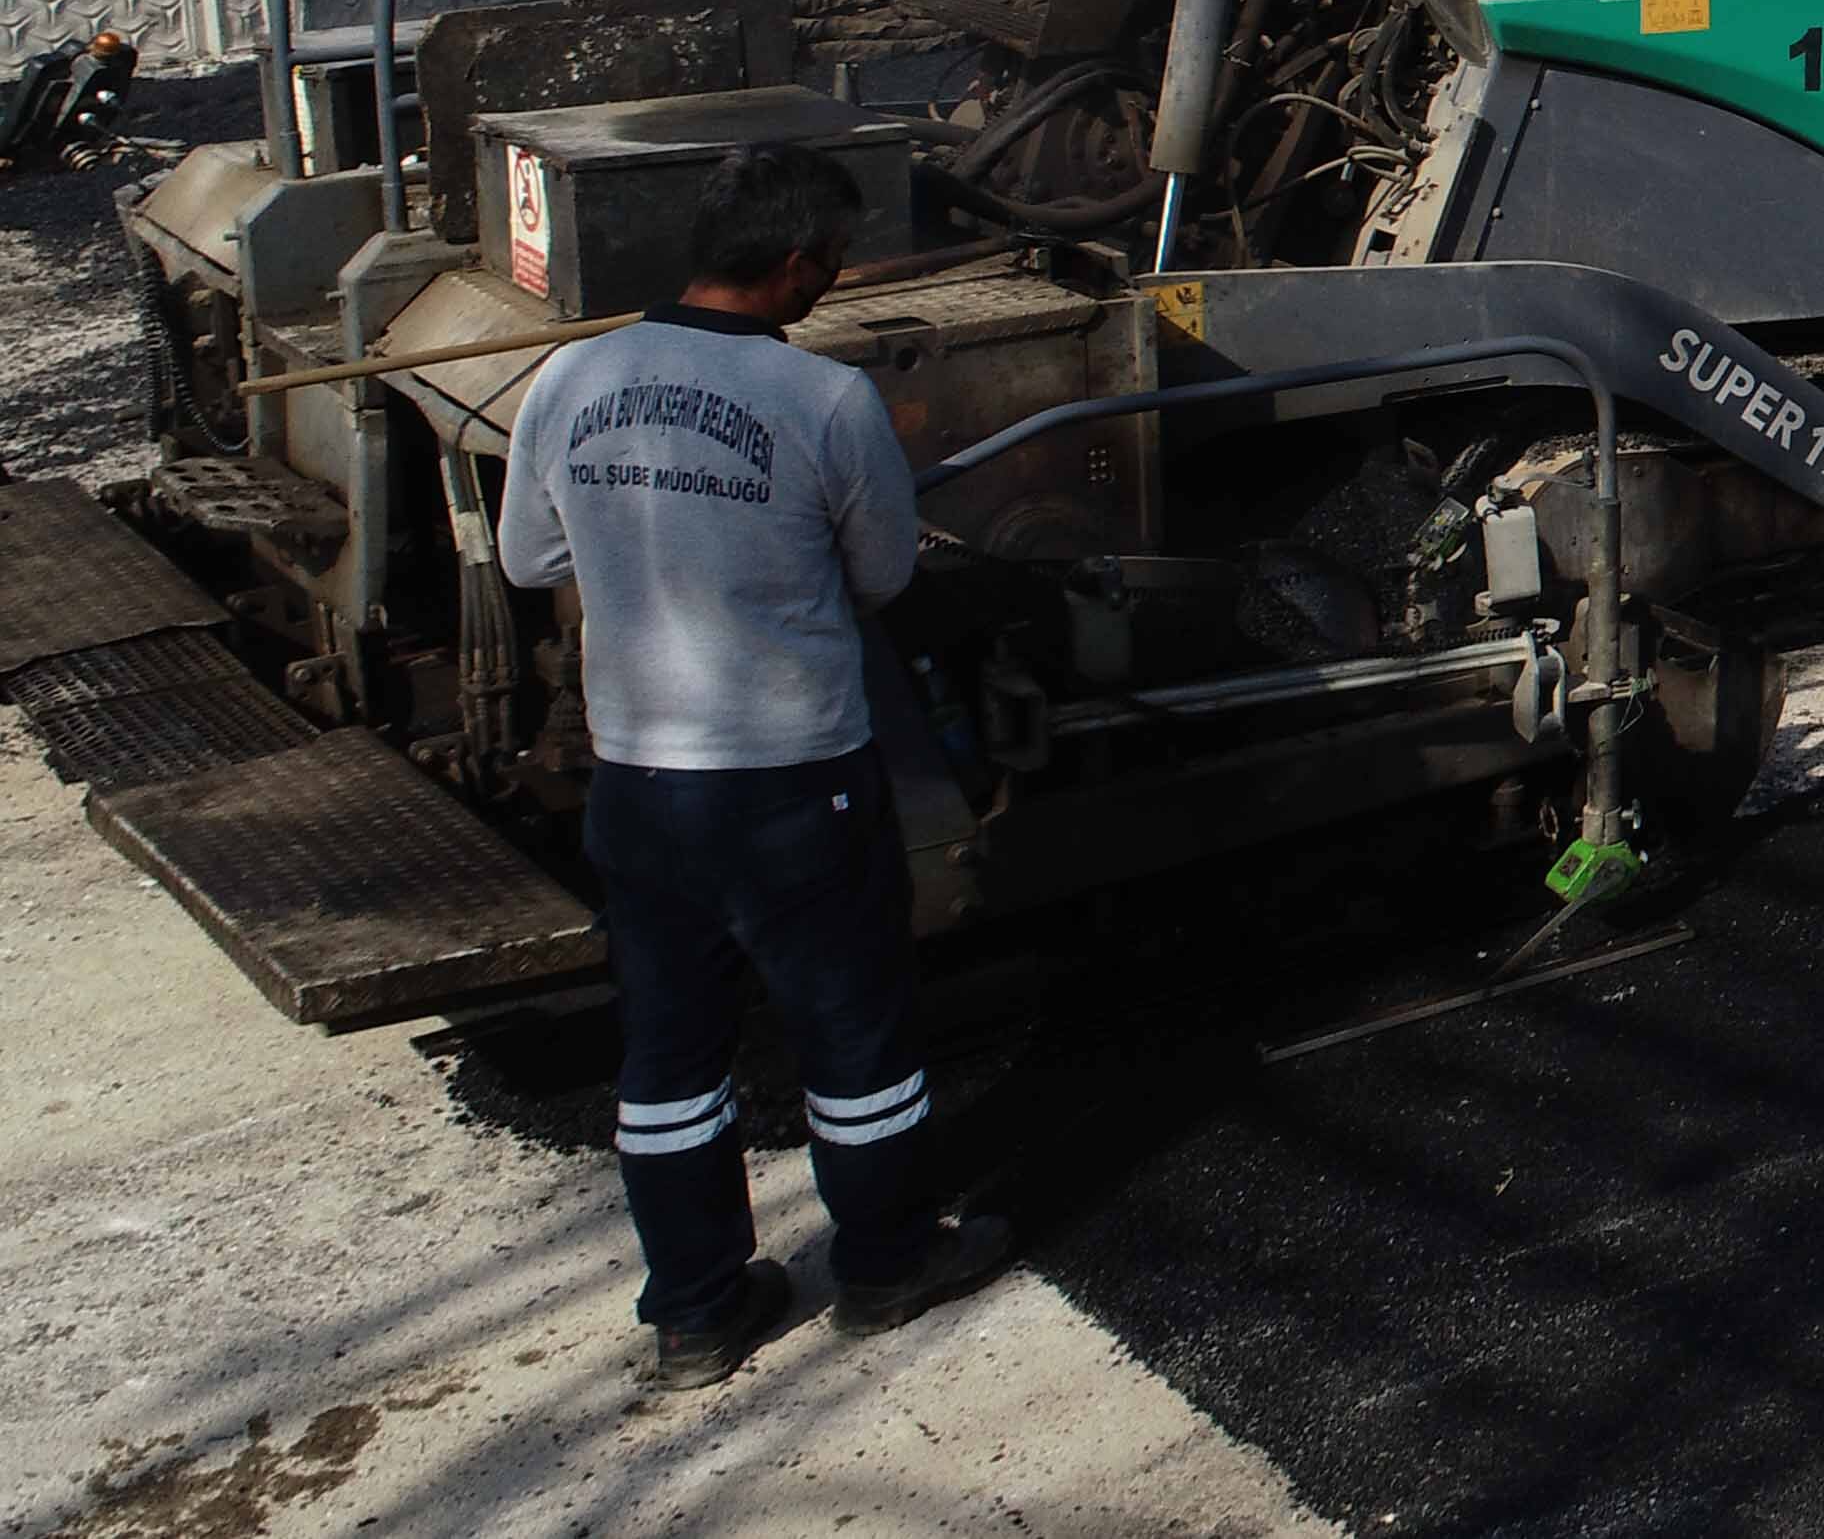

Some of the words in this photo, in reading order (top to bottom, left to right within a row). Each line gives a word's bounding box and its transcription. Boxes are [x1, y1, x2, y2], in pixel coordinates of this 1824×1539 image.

[1659, 328, 1806, 450] SUPER
[567, 392, 616, 459] ADANA
[700, 392, 776, 480] BELEDİYESİ
[569, 464, 601, 486] YOL
[606, 464, 650, 491] ŞUBE
